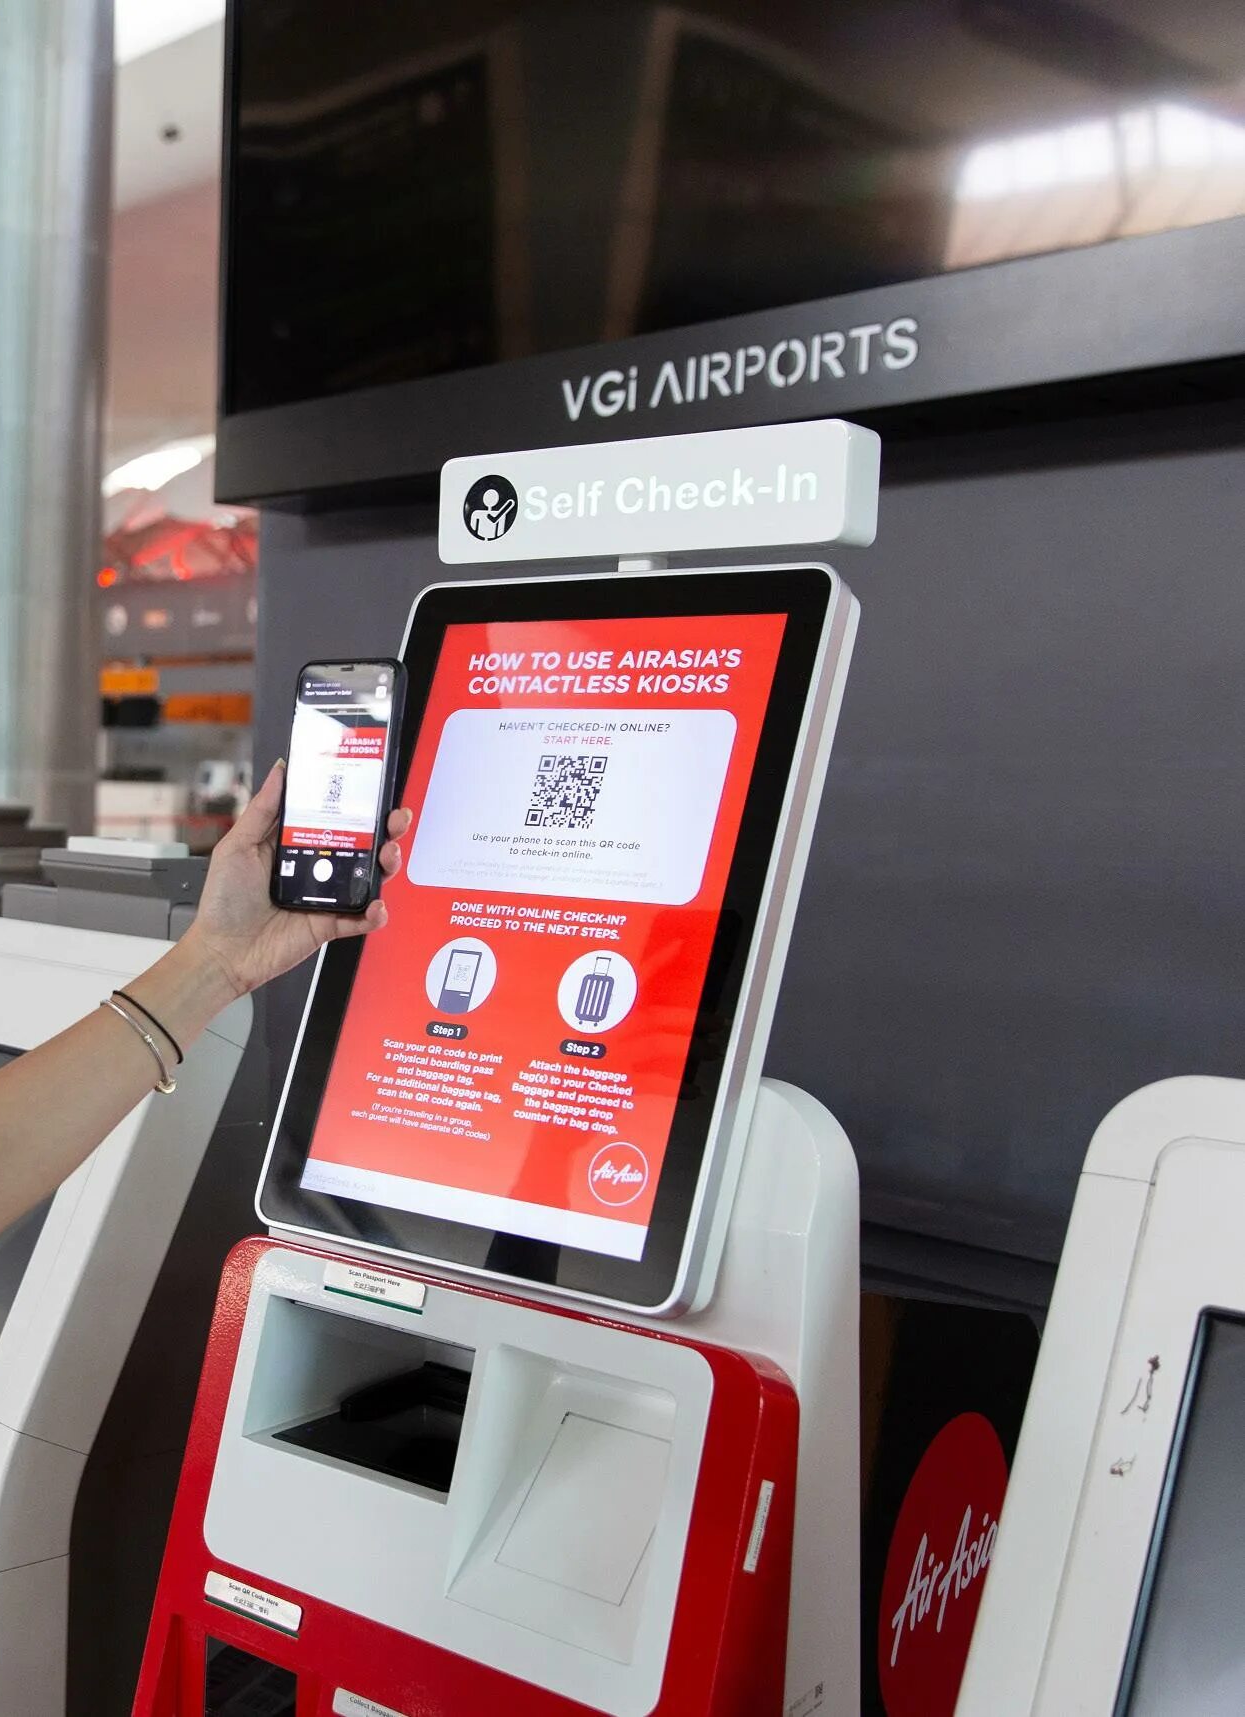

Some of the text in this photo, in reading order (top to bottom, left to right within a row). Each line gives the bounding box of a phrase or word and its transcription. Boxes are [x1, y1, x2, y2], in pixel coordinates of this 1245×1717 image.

[649, 316, 920, 410] AIRPORTS
[523, 463, 818, 523] Self Check-In
[468, 648, 742, 671] HOW TO USE AIRASIA'S
[468, 674, 730, 694] CONTACTLESS KIOSKS
[499, 722, 671, 732] HAVEN'T CHECKED-IN ONLINE?
[543, 735, 614, 745] START HERE.
[472, 832, 641, 850] Use your phone to scan this QR code
[509, 846, 593, 860] to check-in online.
[451, 901, 627, 926] DONE WITH ONLINE CHECK-IN?
[449, 915, 620, 940] PROCEED TO THE NEXT STEPS.
[432, 1024, 461, 1037] Step 1
[383, 1038, 503, 1064] Scan your QR code to print
[565, 1041, 600, 1056] Step 2
[392, 1053, 429, 1066] physical
[430, 1057, 471, 1074] boarding
[472, 1064, 494, 1076] pass
[397, 1064, 475, 1086] and baggage tag.
[529, 1059, 628, 1083] Attach the baggage
[366, 1072, 381, 1082] For
[383, 1076, 393, 1085] an
[395, 1076, 440, 1092] additional
[441, 1084, 482, 1100] baggage
[519, 1070, 633, 1097] tag(s) to your Checked
[377, 1086, 484, 1112] scan the QR code again.
[511, 1082, 634, 1111] Baggage and proceed to
[371, 1102, 380, 1111] (If
[403, 1107, 434, 1122] traveling
[435, 1113, 442, 1121] in
[524, 1097, 614, 1121] the baggage drop
[351, 1109, 491, 1142] each guest will have separate QR codes)
[513, 1109, 619, 1136] counter for bag drop.
[348, 1269, 401, 1288] Scan Passport Here
[228, 1582, 242, 1591] Scan
[242, 1587, 251, 1595] QR
[252, 1592, 265, 1602] Code
